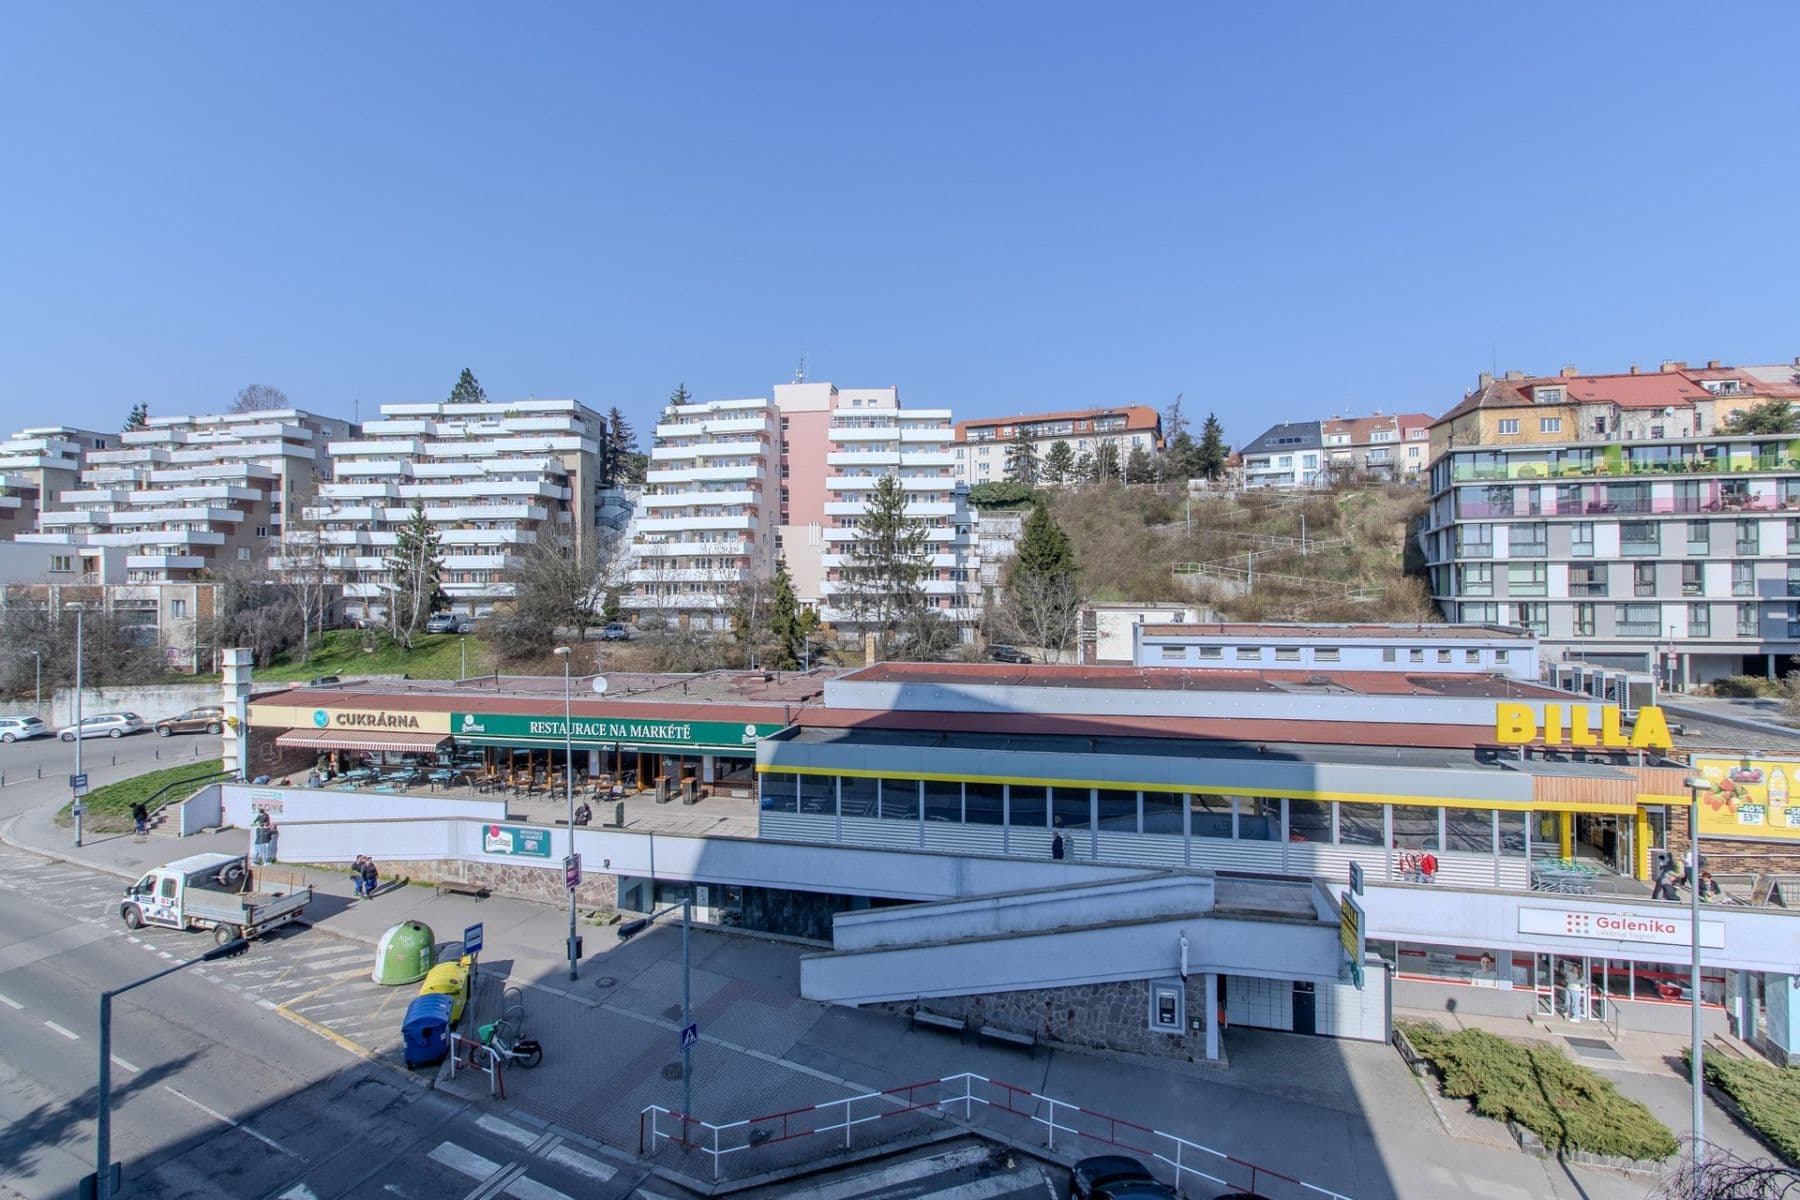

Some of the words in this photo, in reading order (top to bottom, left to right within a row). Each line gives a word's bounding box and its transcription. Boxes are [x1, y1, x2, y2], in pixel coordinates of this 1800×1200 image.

[336, 711, 420, 729] CUKRÁRNA
[1496, 703, 1674, 749] BILLA
[530, 721, 607, 736] RESTAURACE
[610, 724, 627, 737] NA
[630, 724, 691, 740] MARKÉTĚ
[1596, 916, 1676, 934] Galenika
